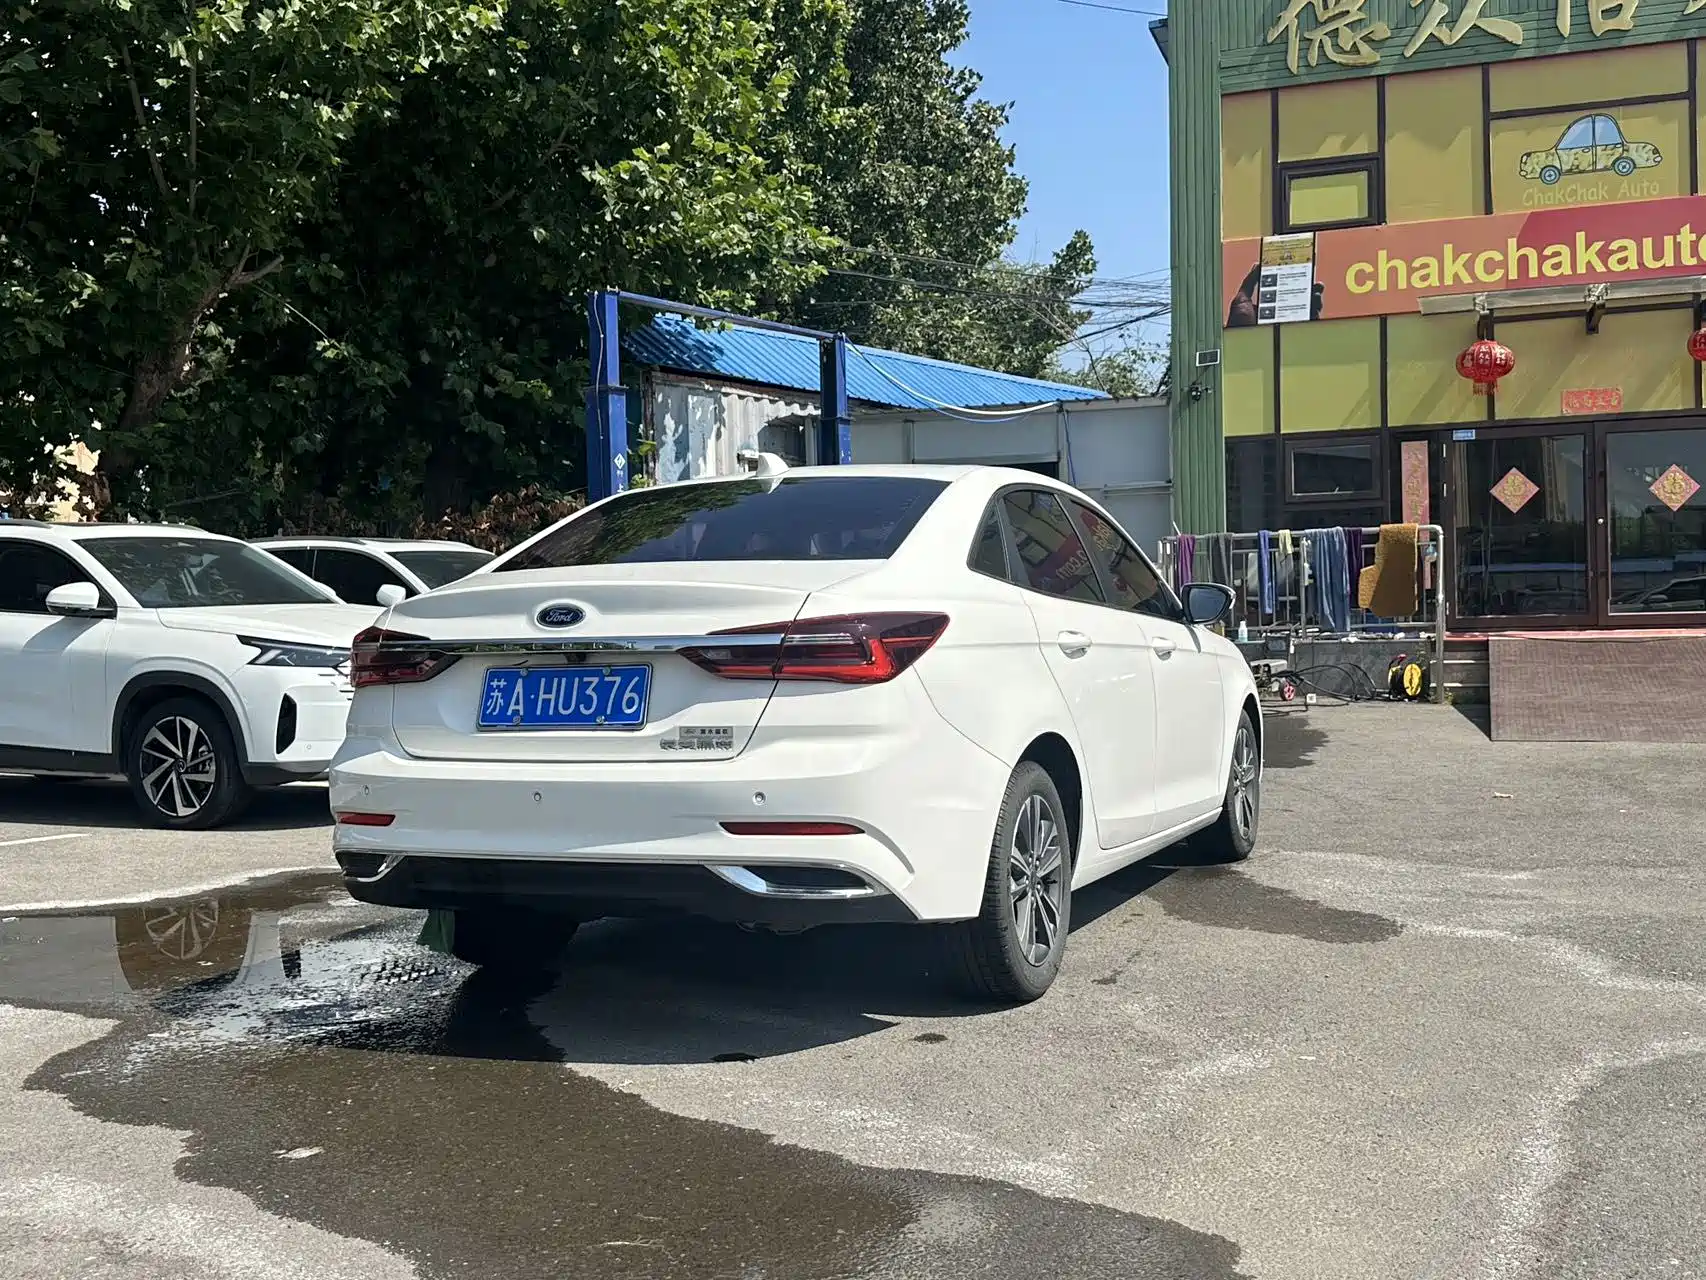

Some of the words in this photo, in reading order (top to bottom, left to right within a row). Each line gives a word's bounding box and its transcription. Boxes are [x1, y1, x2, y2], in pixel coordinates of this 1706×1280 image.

[1522, 181, 1608, 206] ChakChak
[1617, 178, 1660, 199] Auto
[545, 609, 573, 623] Ford
